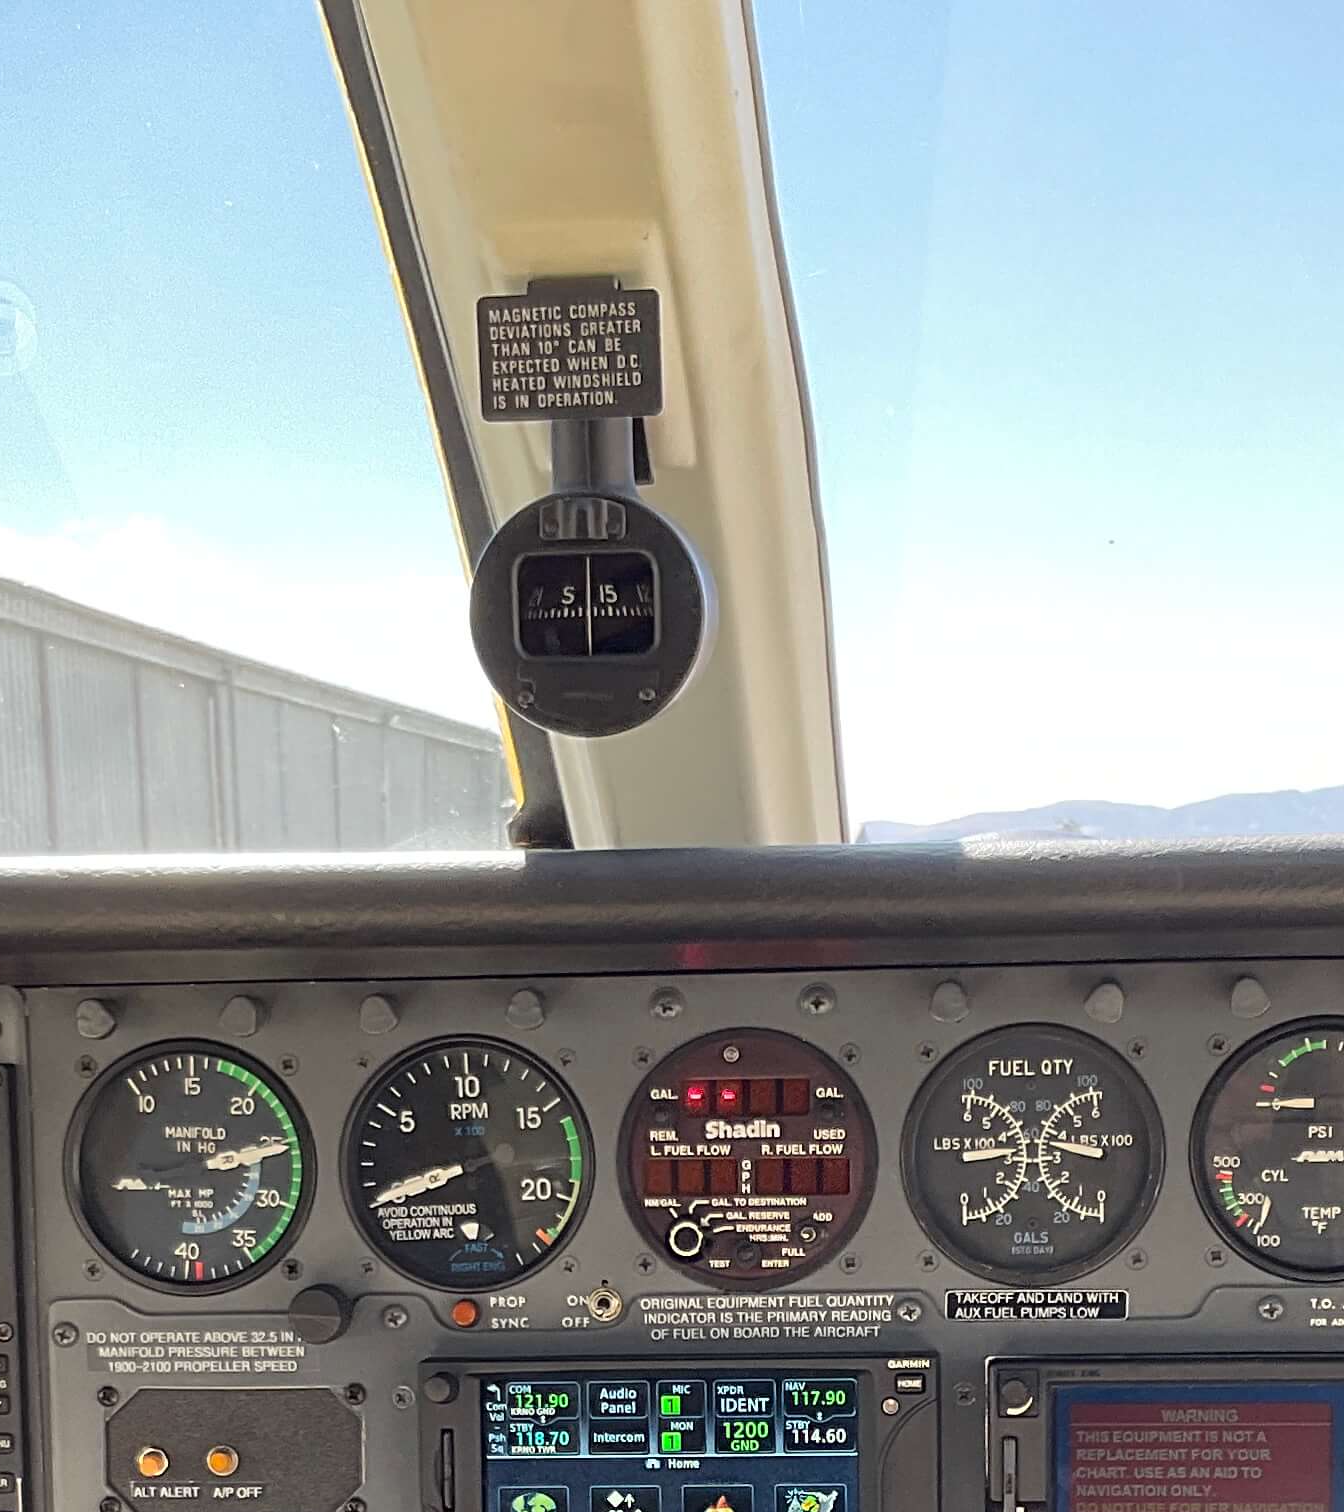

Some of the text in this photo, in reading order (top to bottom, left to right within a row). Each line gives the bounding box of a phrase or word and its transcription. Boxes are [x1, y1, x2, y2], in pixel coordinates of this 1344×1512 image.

[488, 303, 635, 323] MAGNETIC COMPASS
[490, 320, 641, 339] DEVIATIONS GREATER
[492, 341, 530, 356] THAN
[568, 339, 598, 354] CAN
[604, 338, 621, 351] BE
[492, 356, 608, 374] EXPECTED WHEN
[492, 372, 642, 390] HEATED WINDSHIELD
[493, 394, 506, 408] IS
[515, 393, 529, 408] IN
[599, 585, 618, 602] 15
[988, 1060, 1073, 1076] FUEL QTY
[184, 1077, 200, 1095] 15
[455, 1076, 480, 1098] 10
[650, 1088, 844, 1100] GAL. GAL.
[230, 1098, 255, 1115] 20
[450, 1104, 489, 1120] RPM
[516, 1107, 541, 1129] 15
[165, 1126, 226, 1140] MANIFOLD
[649, 1129, 845, 1142] REM. USED
[706, 1120, 780, 1140] Shadin
[1308, 1125, 1333, 1138] PSI
[177, 1142, 216, 1153] IN HG
[664, 1145, 730, 1156] FUEL FLOW
[776, 1144, 843, 1155] FUEL FLOW
[1262, 1169, 1288, 1182] CYL
[520, 1178, 552, 1200] 20
[377, 1204, 476, 1218] AVOID CONTINUOUS
[1302, 1207, 1341, 1219] TEMP
[382, 1216, 452, 1229] OPERATION IN
[390, 1228, 454, 1241] YELLOW ARC
[490, 1297, 526, 1308] PROP
[640, 1295, 894, 1311] ORIGINAL EQUIPMENT FUEL QUANTITY
[956, 1292, 1119, 1303] TAKEOFF AND LAND WITH
[1310, 1299, 1335, 1309] T.O.
[643, 1309, 892, 1324] INDICATOR IS THE PRIMARY READING
[955, 1308, 1099, 1319] AUX FUEL PUMPS LOW
[491, 1317, 529, 1328] SYNC
[87, 1332, 277, 1343] DO NOT OPERATE ABOVE 32.5
[651, 1325, 881, 1340] OF FUEL ON BOARD THE AIRCRAFT
[99, 1346, 305, 1357] MANIFOLD PRESSURE BETWEEN
[174, 1361, 250, 1372] PROPELLER
[254, 1361, 297, 1372] SPEED
[887, 1360, 929, 1369] GARMIN
[600, 1387, 636, 1401] Audio
[600, 1401, 636, 1415] Panel
[720, 1391, 846, 1413] IDENT 117.90
[1161, 1409, 1238, 1423] WARNING
[594, 1431, 644, 1444] Intercom
[723, 1423, 768, 1438] 1200
[791, 1428, 846, 1444] 114.60
[1076, 1430, 1267, 1443] THIS EQUIPMENT IS NOT A
[516, 1431, 569, 1446] 118.70
[668, 1458, 700, 1469] Home
[134, 1487, 262, 1498] ALT ALERT A/P OFF
